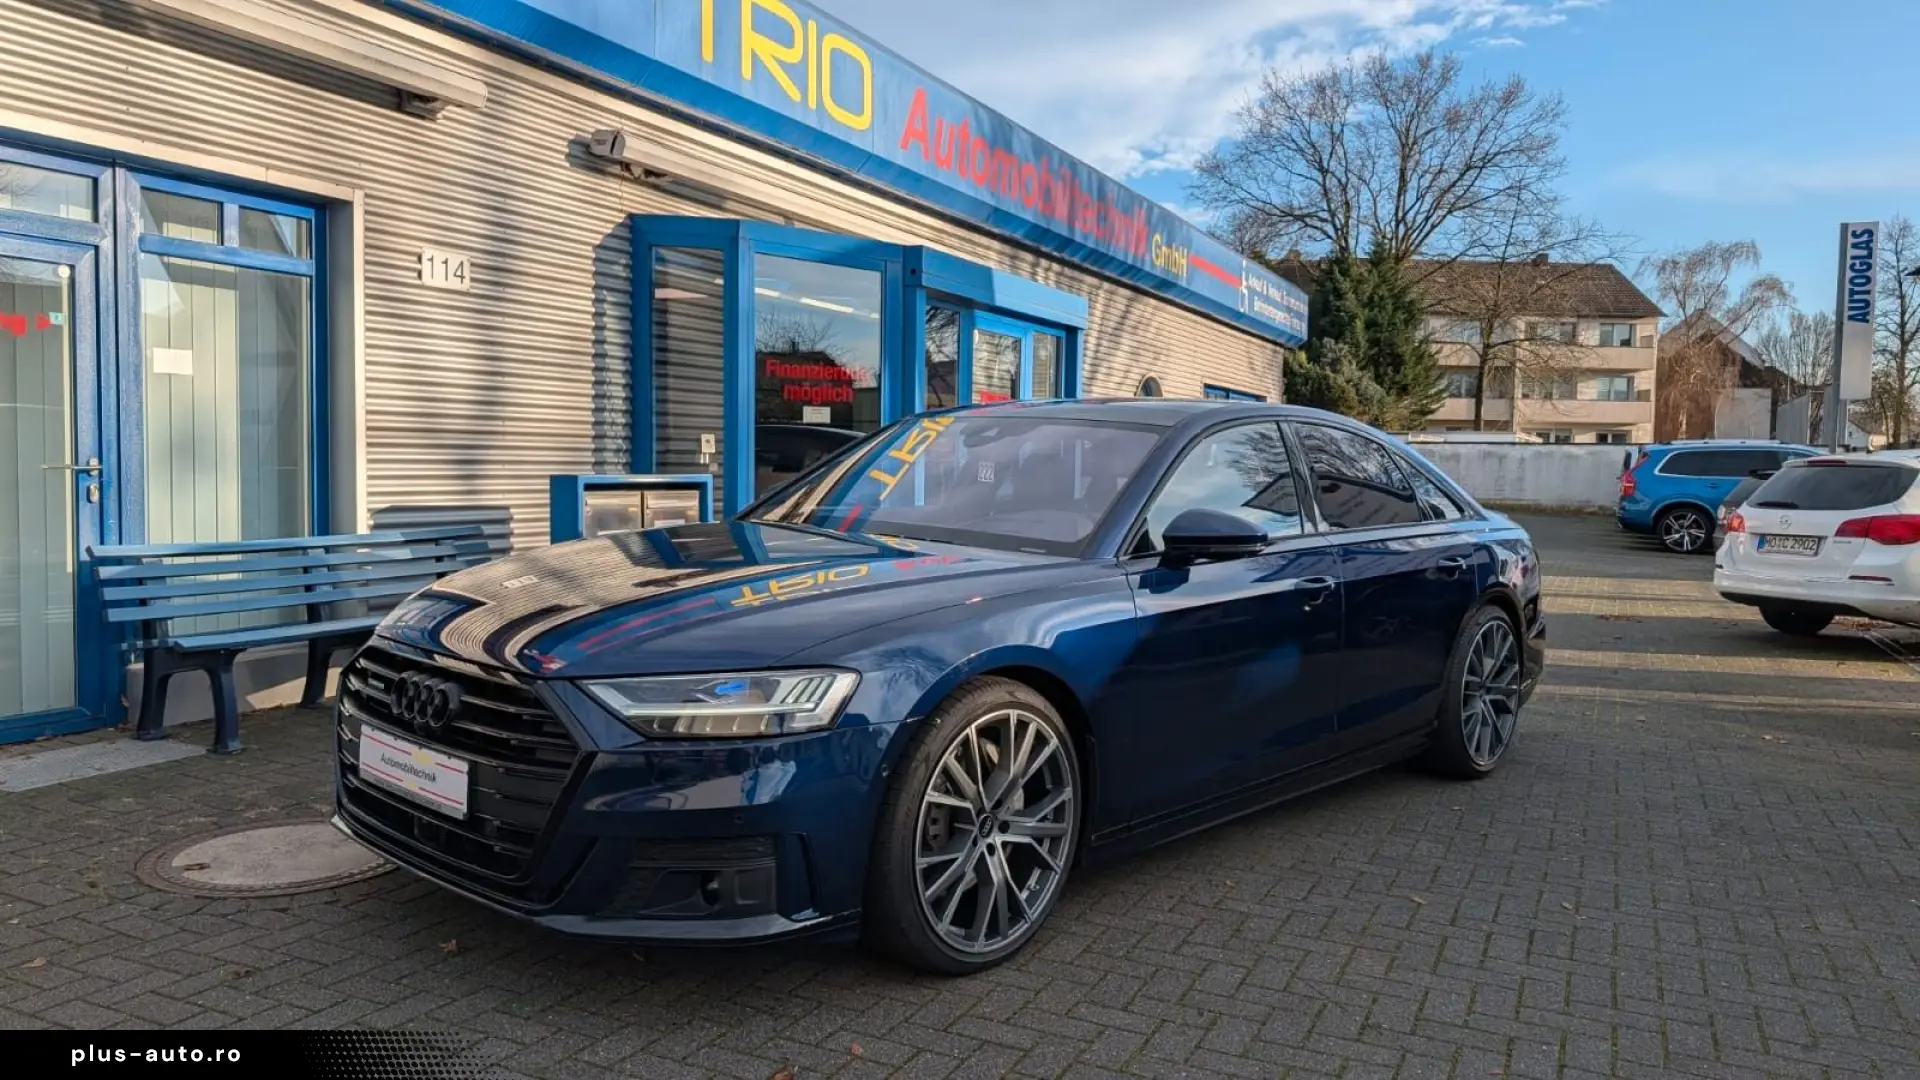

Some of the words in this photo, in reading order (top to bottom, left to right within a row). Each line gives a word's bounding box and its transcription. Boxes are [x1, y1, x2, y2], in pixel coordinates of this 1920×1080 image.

[900, 86, 1149, 257] Automobiltechnik
[1152, 232, 1188, 278] GmbH
[426, 253, 467, 285] 114
[1847, 227, 1874, 324] AUTOGLAS
[783, 381, 855, 405] möglich
[1790, 537, 1817, 551] 2902
[380, 752, 437, 783] Automobiltechnik
